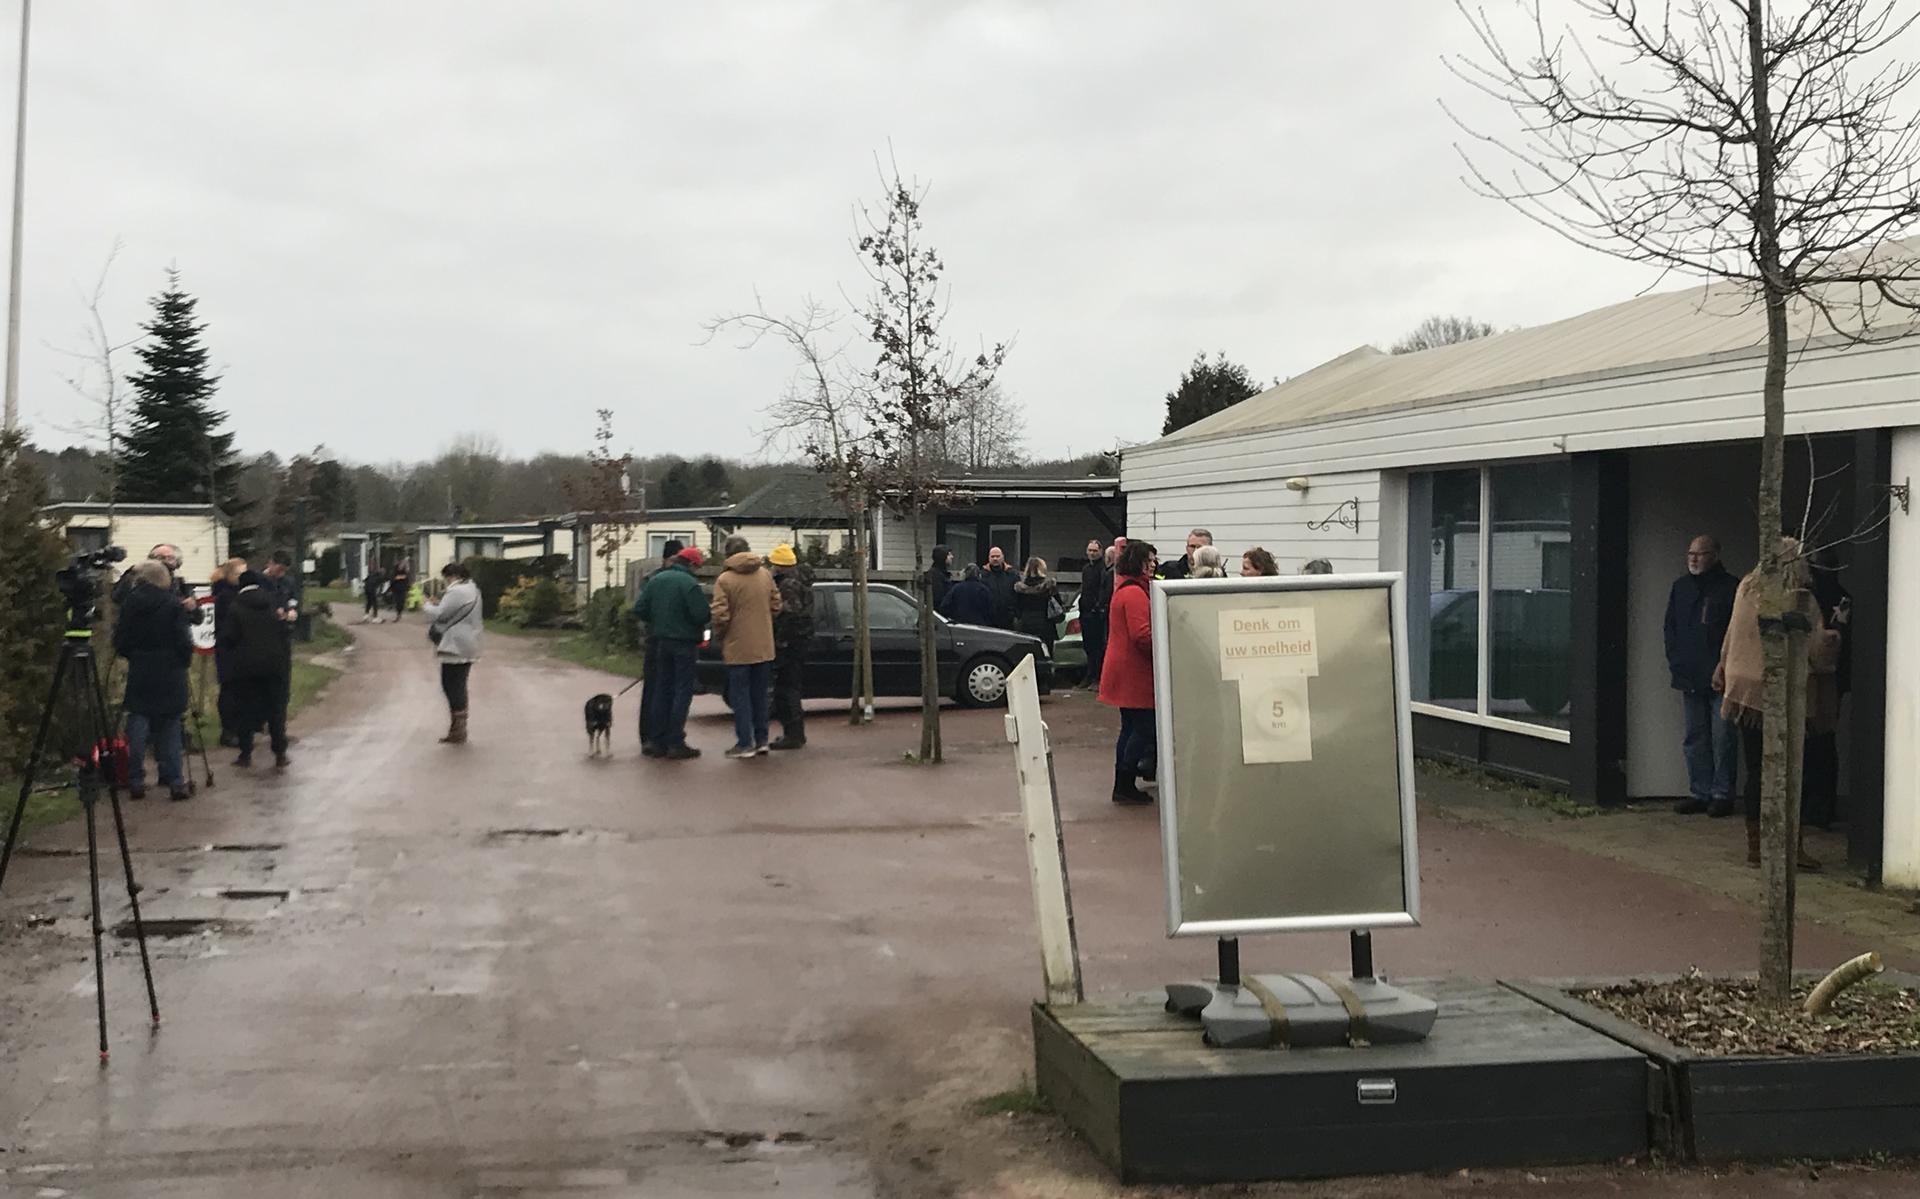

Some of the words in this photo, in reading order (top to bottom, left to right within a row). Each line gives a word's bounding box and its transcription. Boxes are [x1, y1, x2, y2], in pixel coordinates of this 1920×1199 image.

[1233, 618, 1270, 632] Denk
[1278, 619, 1301, 630] om
[1225, 645, 1247, 657] uw
[1251, 639, 1312, 656] snelheid
[1272, 700, 1284, 718] 5
